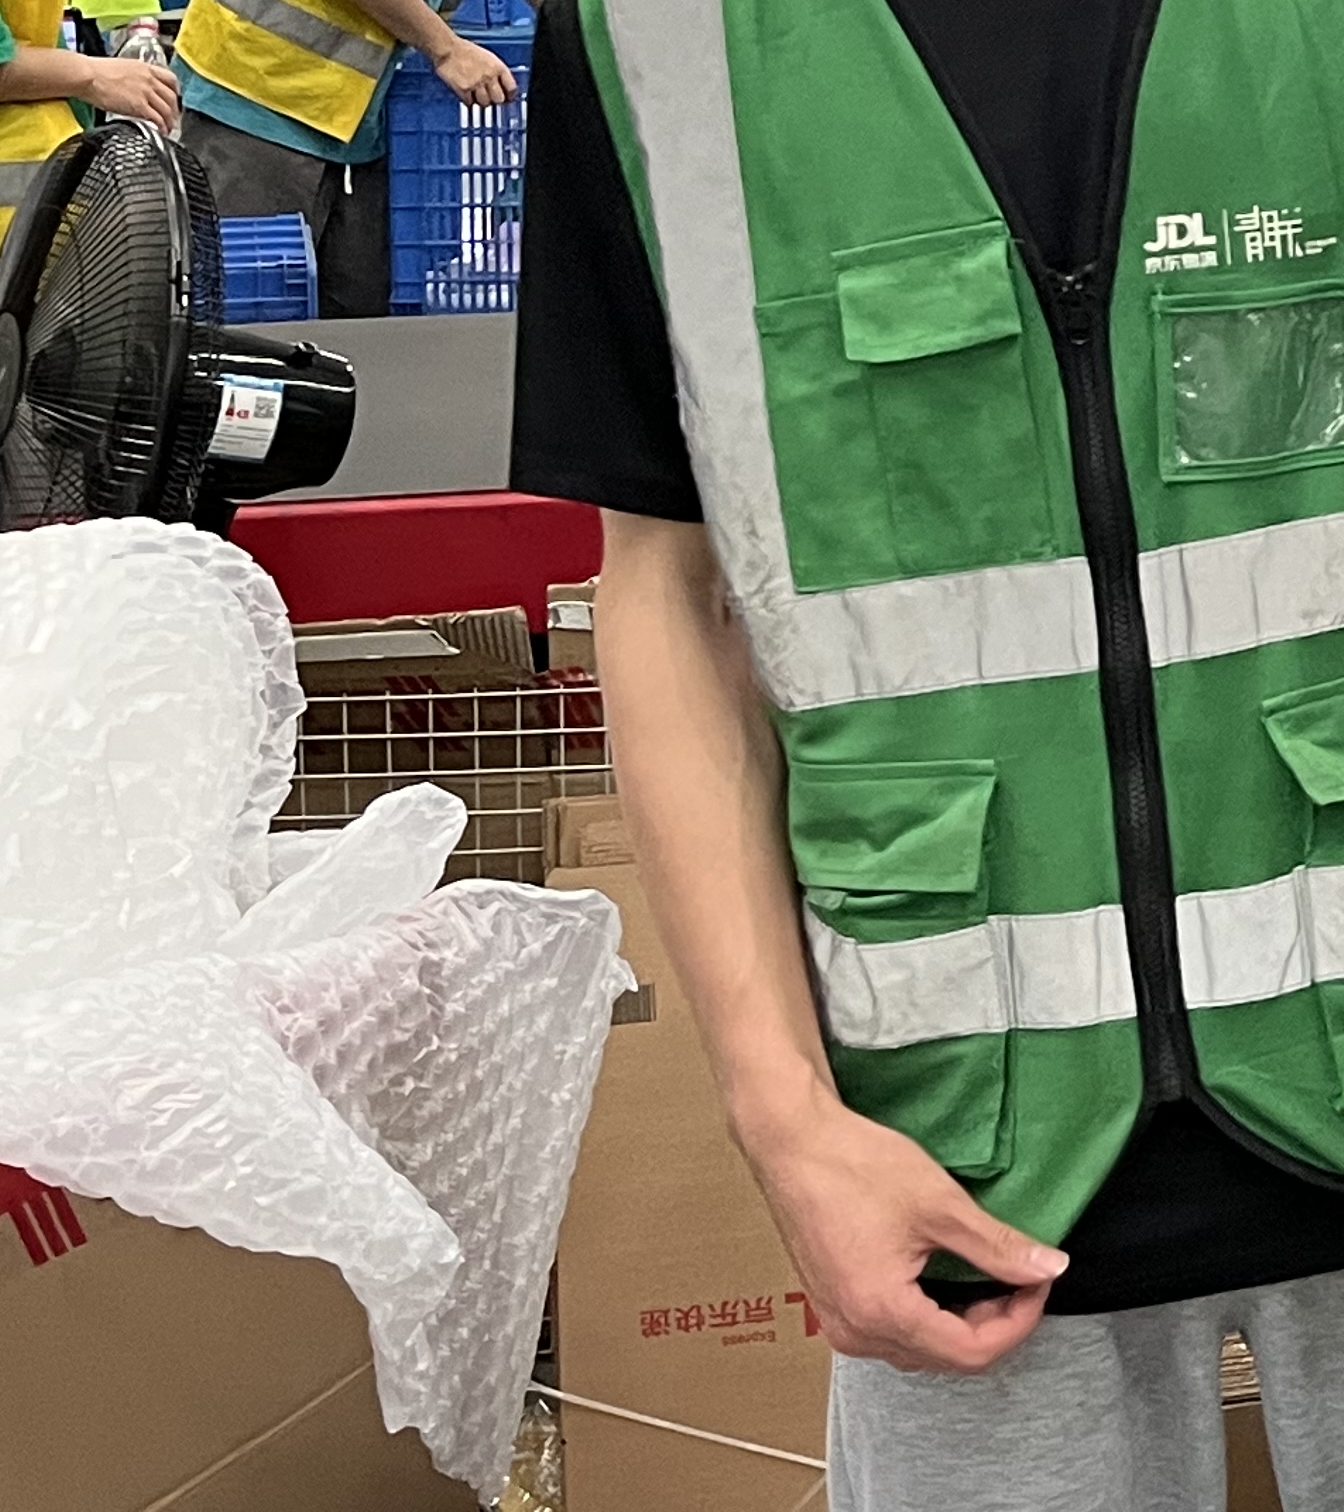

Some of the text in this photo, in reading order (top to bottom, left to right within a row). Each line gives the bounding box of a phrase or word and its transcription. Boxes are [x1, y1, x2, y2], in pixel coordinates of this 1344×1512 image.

[1143, 212, 1217, 252] JDL
[639, 1295, 775, 1339] 京东快递
